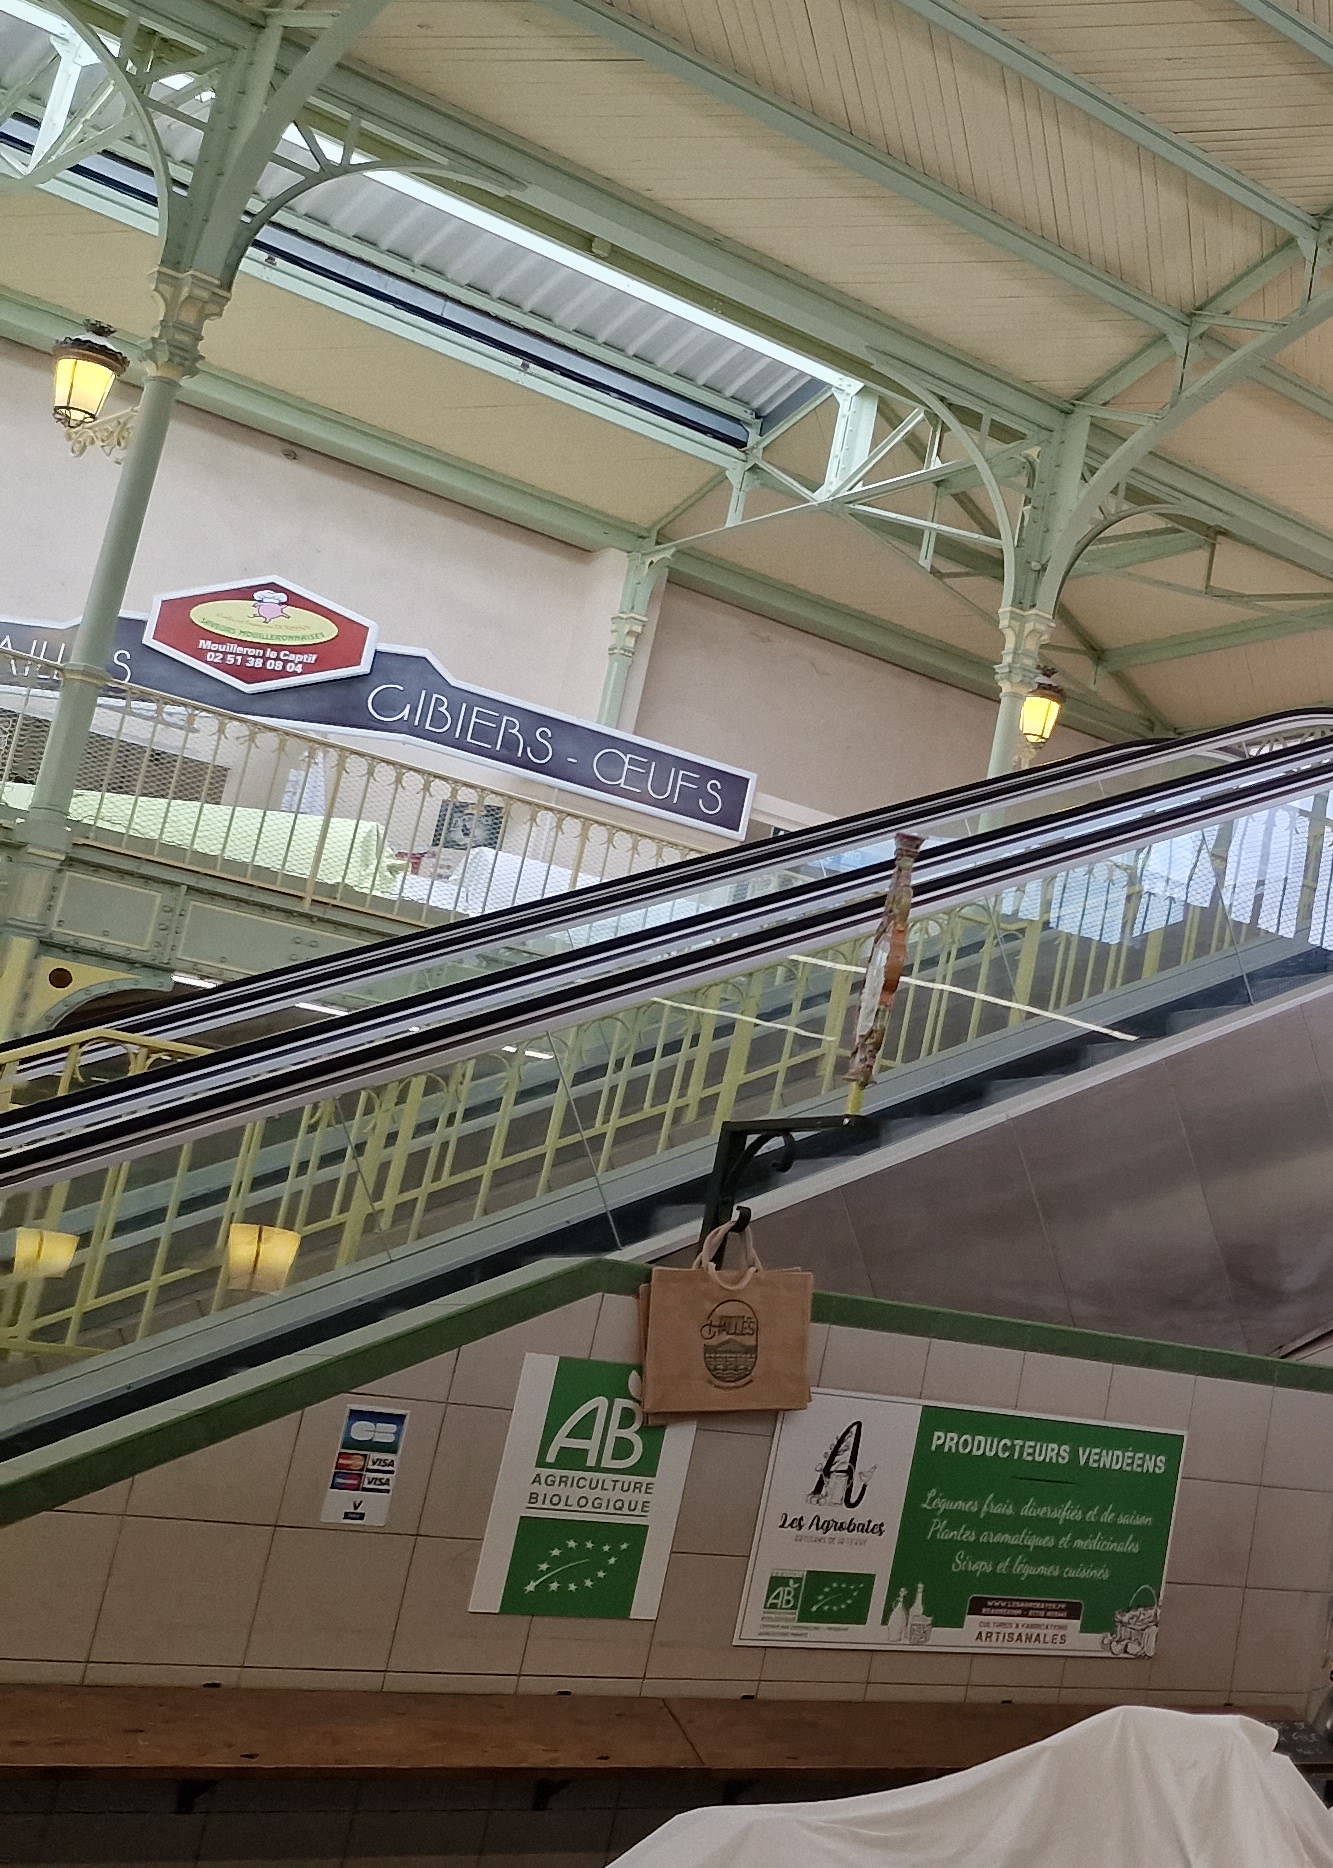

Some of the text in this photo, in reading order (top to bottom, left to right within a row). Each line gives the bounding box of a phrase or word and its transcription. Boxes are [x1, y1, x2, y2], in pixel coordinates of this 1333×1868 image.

[198, 640, 318, 664] Mouilleron le Captif
[206, 652, 303, 673] 02 51 38 08 04
[367, 684, 554, 765] GIBIERS
[545, 1396, 643, 1469] AB
[371, 1457, 395, 1468] VISA
[931, 1431, 1166, 1474] PRODUCTEURS VENDÉENS
[367, 1476, 390, 1487] VISA
[531, 1473, 655, 1495] AGRICULTURE
[528, 1492, 650, 1513] BIOLOGIQUE
[921, 1488, 978, 1515] Légumes
[1020, 1497, 1082, 1524] diversifiés
[1086, 1504, 1099, 1522] et
[1101, 1504, 1114, 1523] de
[1117, 1512, 1152, 1526] saison
[779, 1513, 805, 1532] Les
[927, 1519, 1140, 1553] Plantes aromatiques et médicinales
[952, 1551, 1109, 1580] Sirops et légumes cuisinés
[766, 1586, 794, 1609] AB
[975, 1631, 1067, 1645] ARTISANALES
